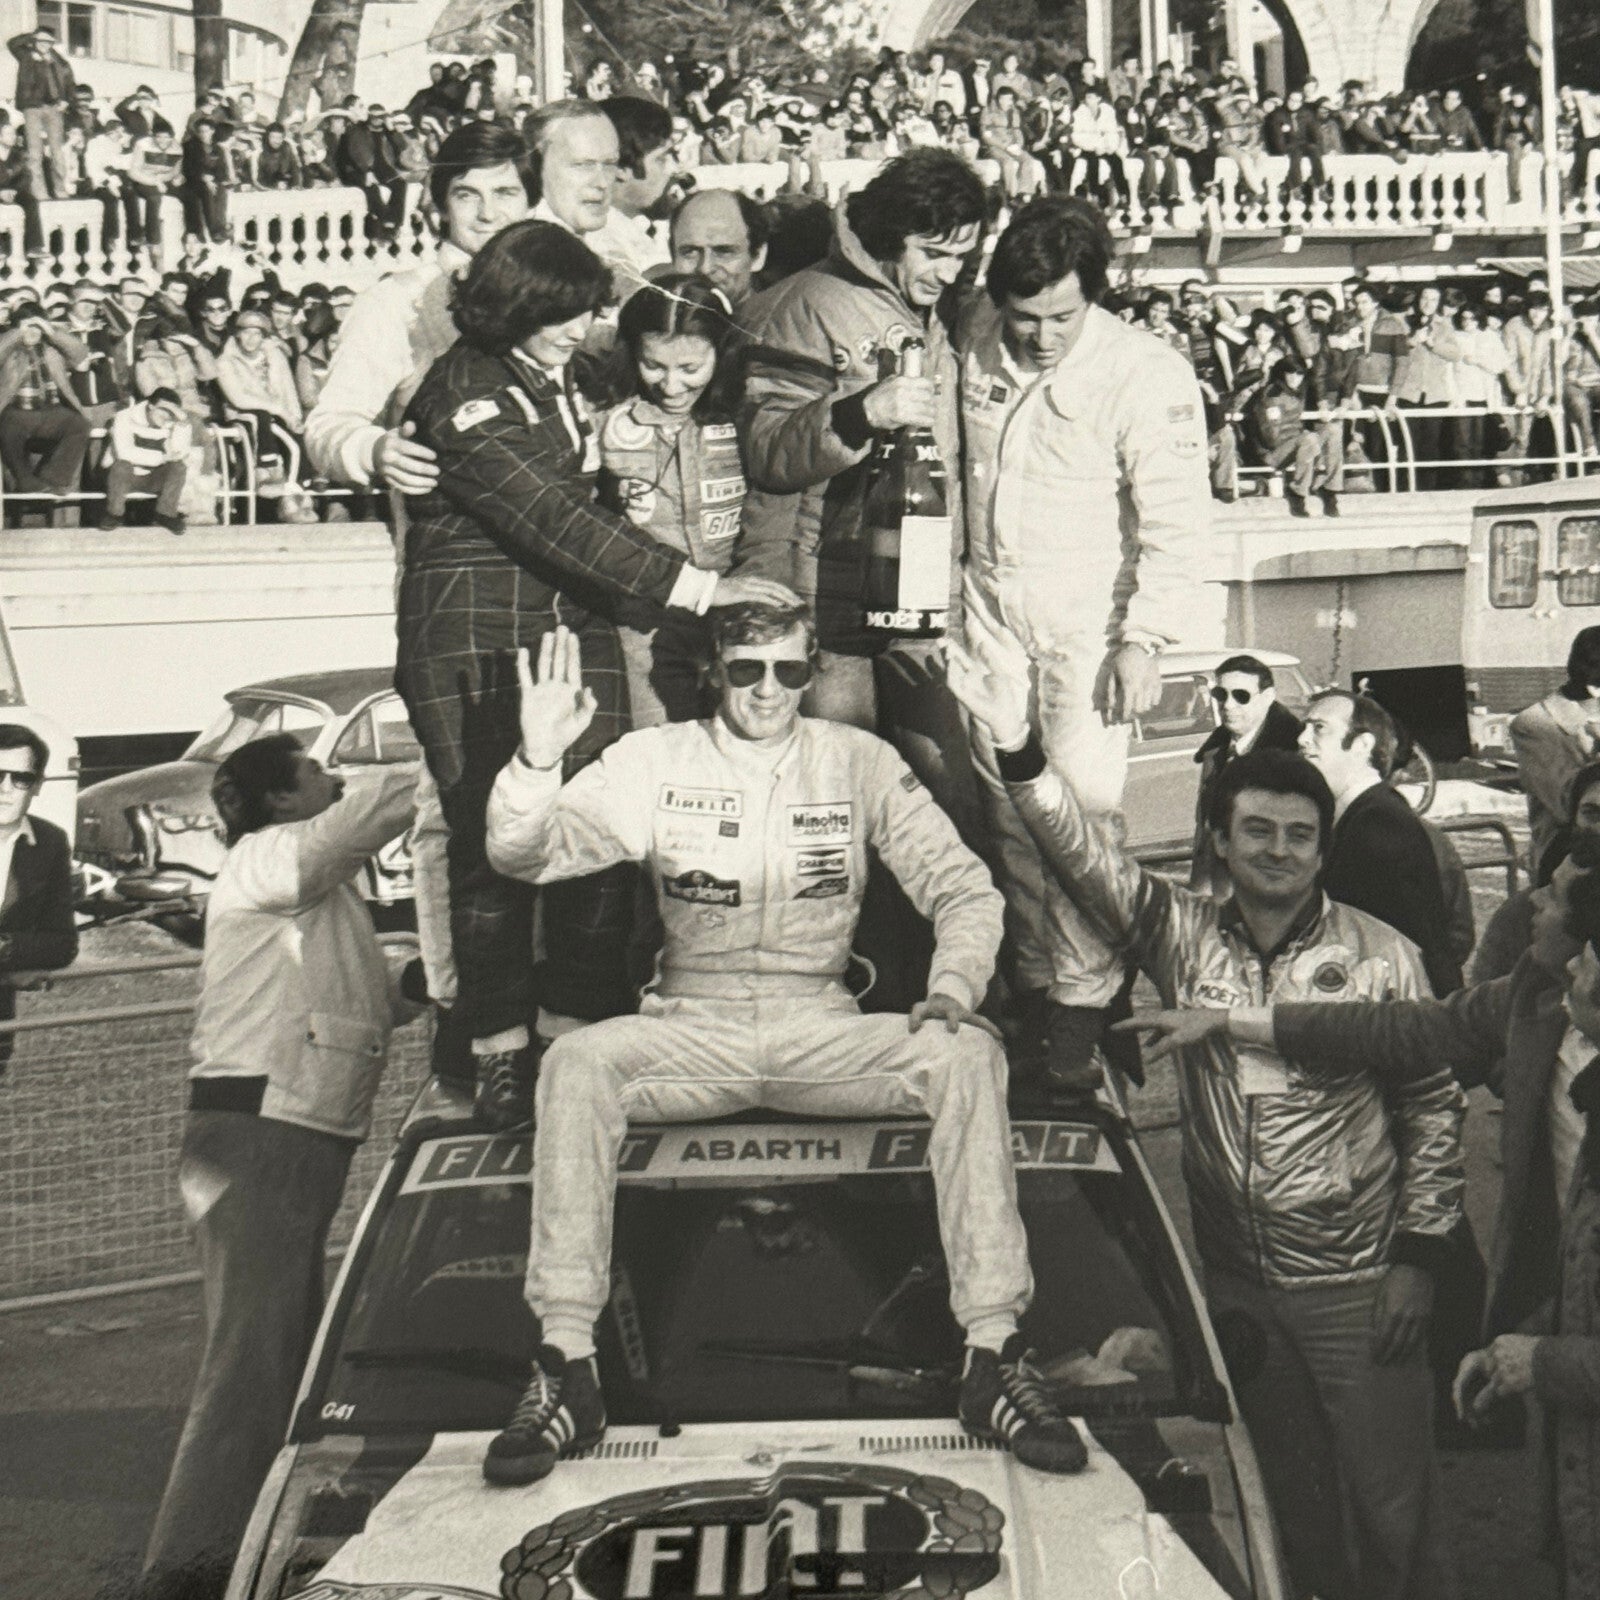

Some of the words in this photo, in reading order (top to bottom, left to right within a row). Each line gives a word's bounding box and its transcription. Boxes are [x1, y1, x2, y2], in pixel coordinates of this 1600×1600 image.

[707, 511, 740, 535] GIT
[793, 810, 849, 828] Minolta
[679, 1138, 842, 1163] ABARTH
[887, 1130, 1089, 1162] FAT
[622, 1496, 886, 1599] FIAT
